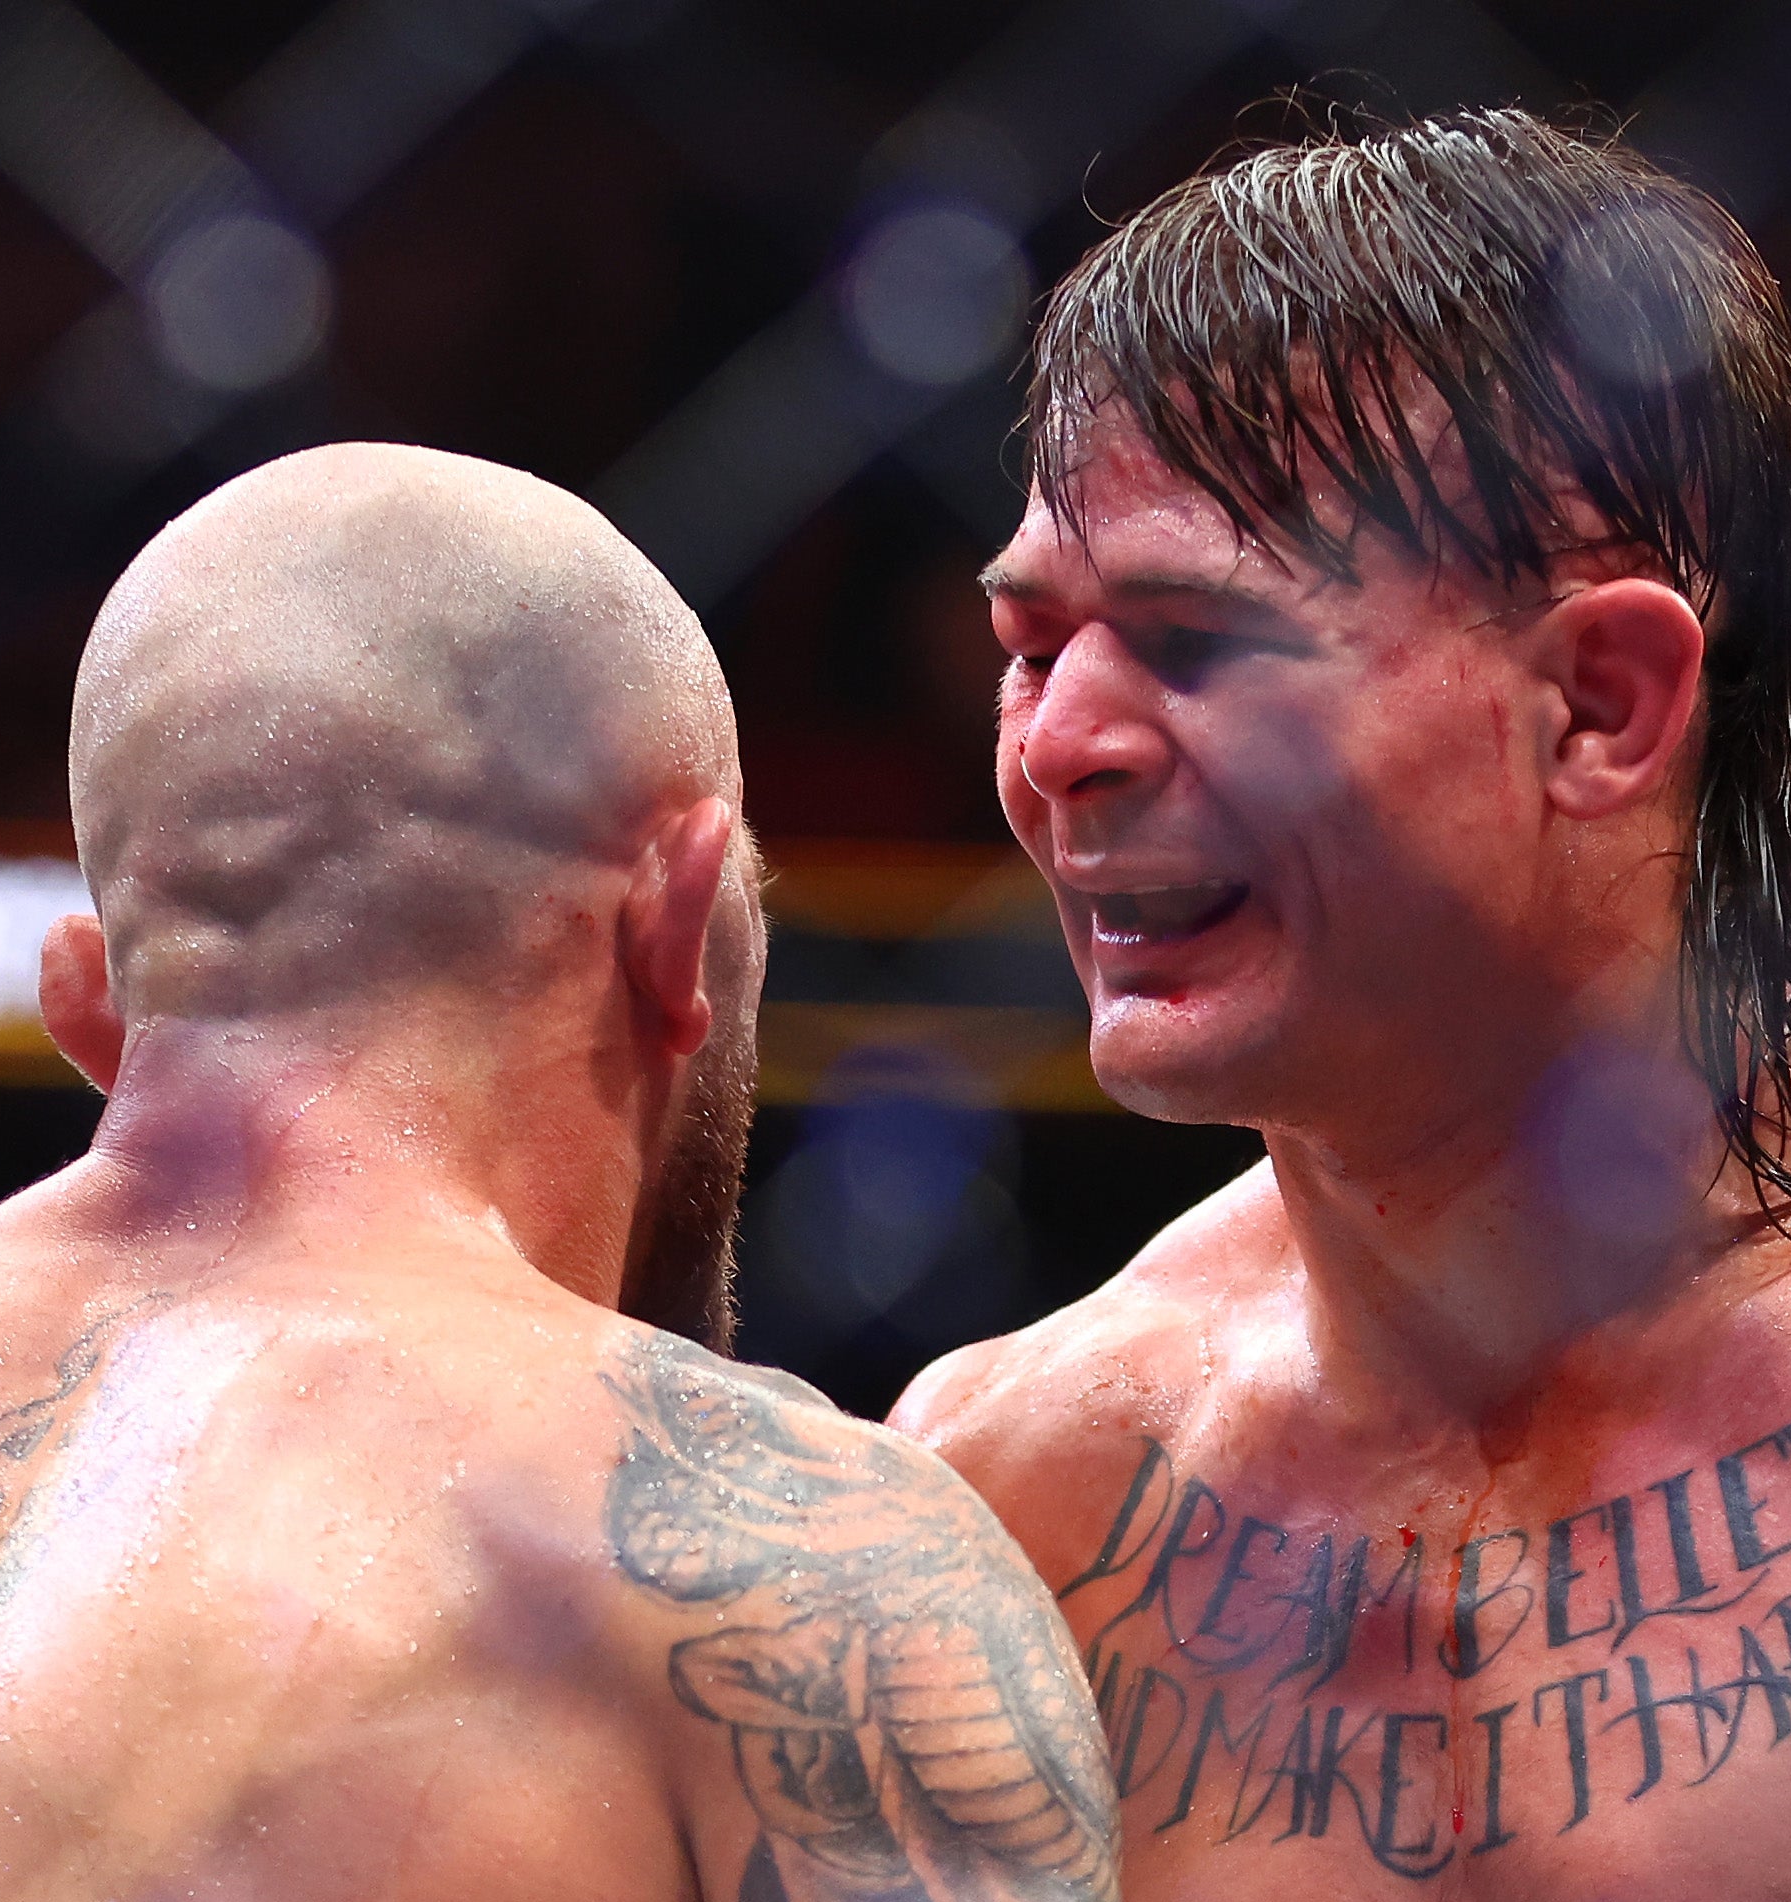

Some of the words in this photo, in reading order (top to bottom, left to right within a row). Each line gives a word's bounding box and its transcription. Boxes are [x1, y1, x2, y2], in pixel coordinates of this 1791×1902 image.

[1058, 1436, 1423, 1698] DREAM
[1086, 1642, 1187, 1798] ND
[1154, 1686, 1456, 1878] MAKE
[1471, 1672, 1610, 1856] IT
